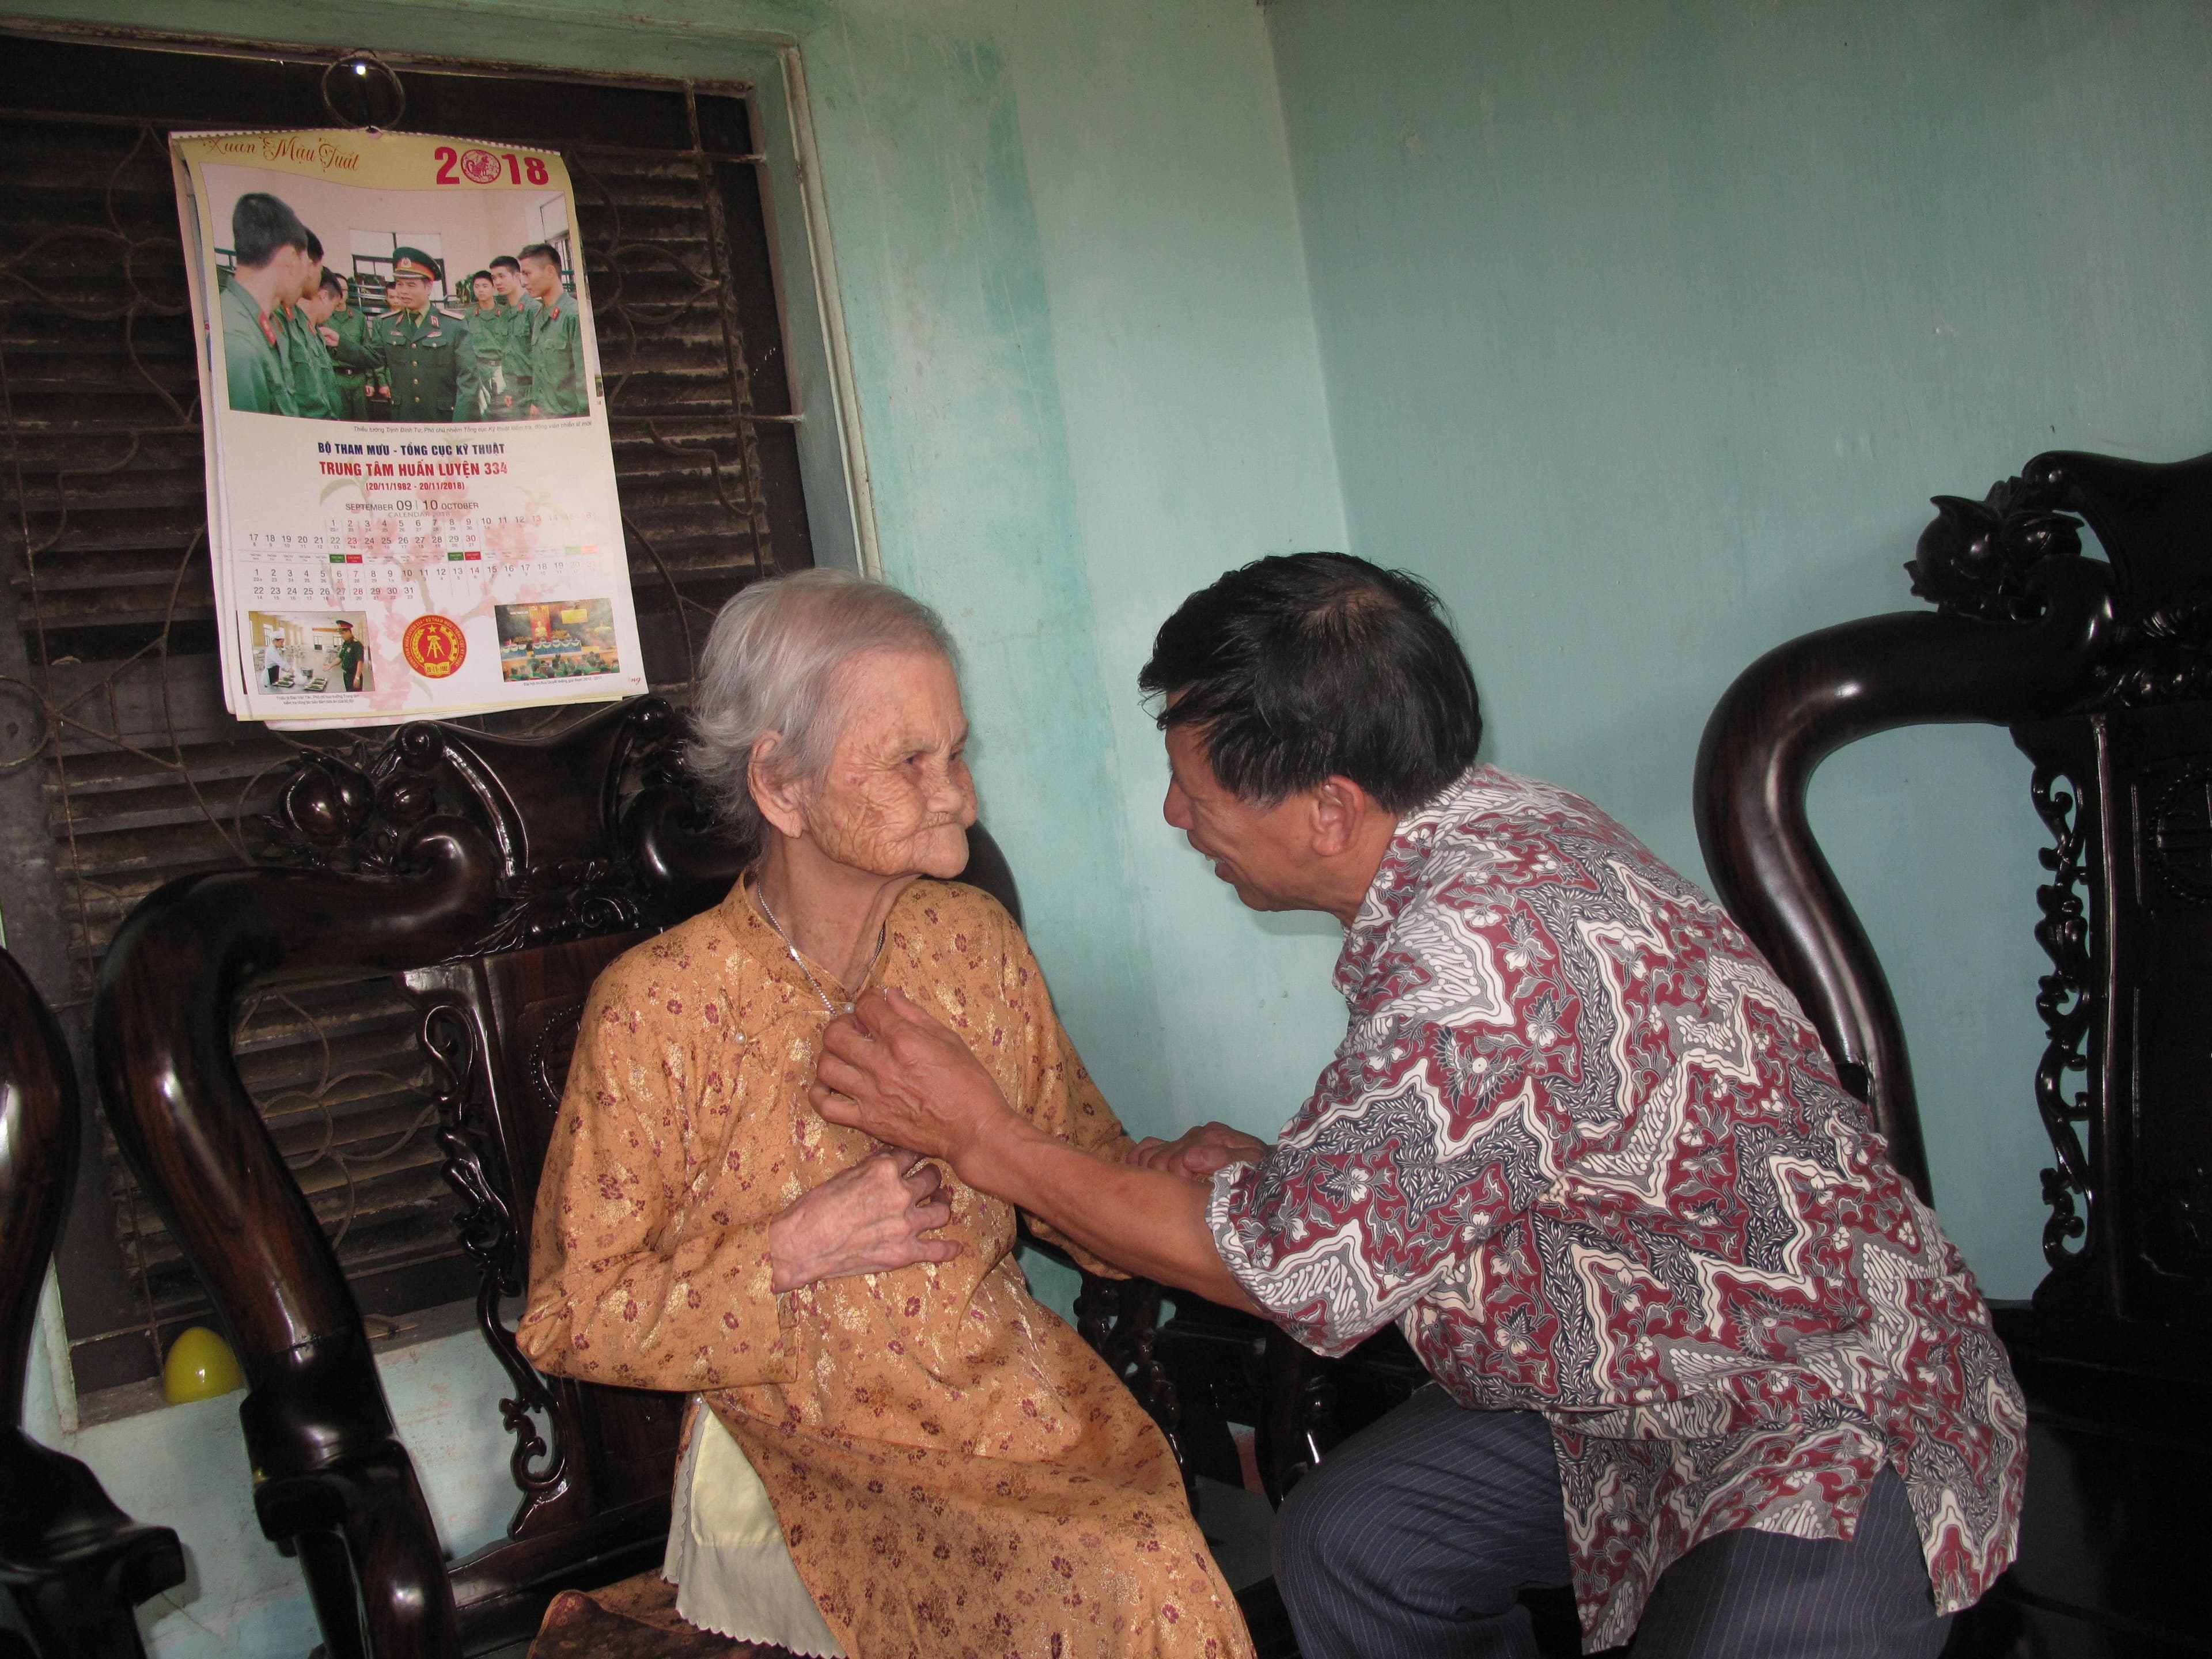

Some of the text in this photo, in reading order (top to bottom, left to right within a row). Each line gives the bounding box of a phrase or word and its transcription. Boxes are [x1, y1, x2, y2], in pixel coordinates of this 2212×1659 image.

[318, 442, 331, 458] BỘ
[335, 443, 363, 455] THAM
[367, 444, 390, 456] MƯU
[400, 442, 428, 456] TỔNG
[432, 444, 452, 458] CỤC
[456, 442, 469, 455] KỸ
[472, 442, 505, 457] THUẬT
[319, 459, 507, 478] TRUNG TÂM HUẤN LUYỆN 334
[366, 482, 464, 491] (20/11/1982 20/11/2018)
[346, 499, 479, 511] SEPTEMBER 09 10 OCTOBER
